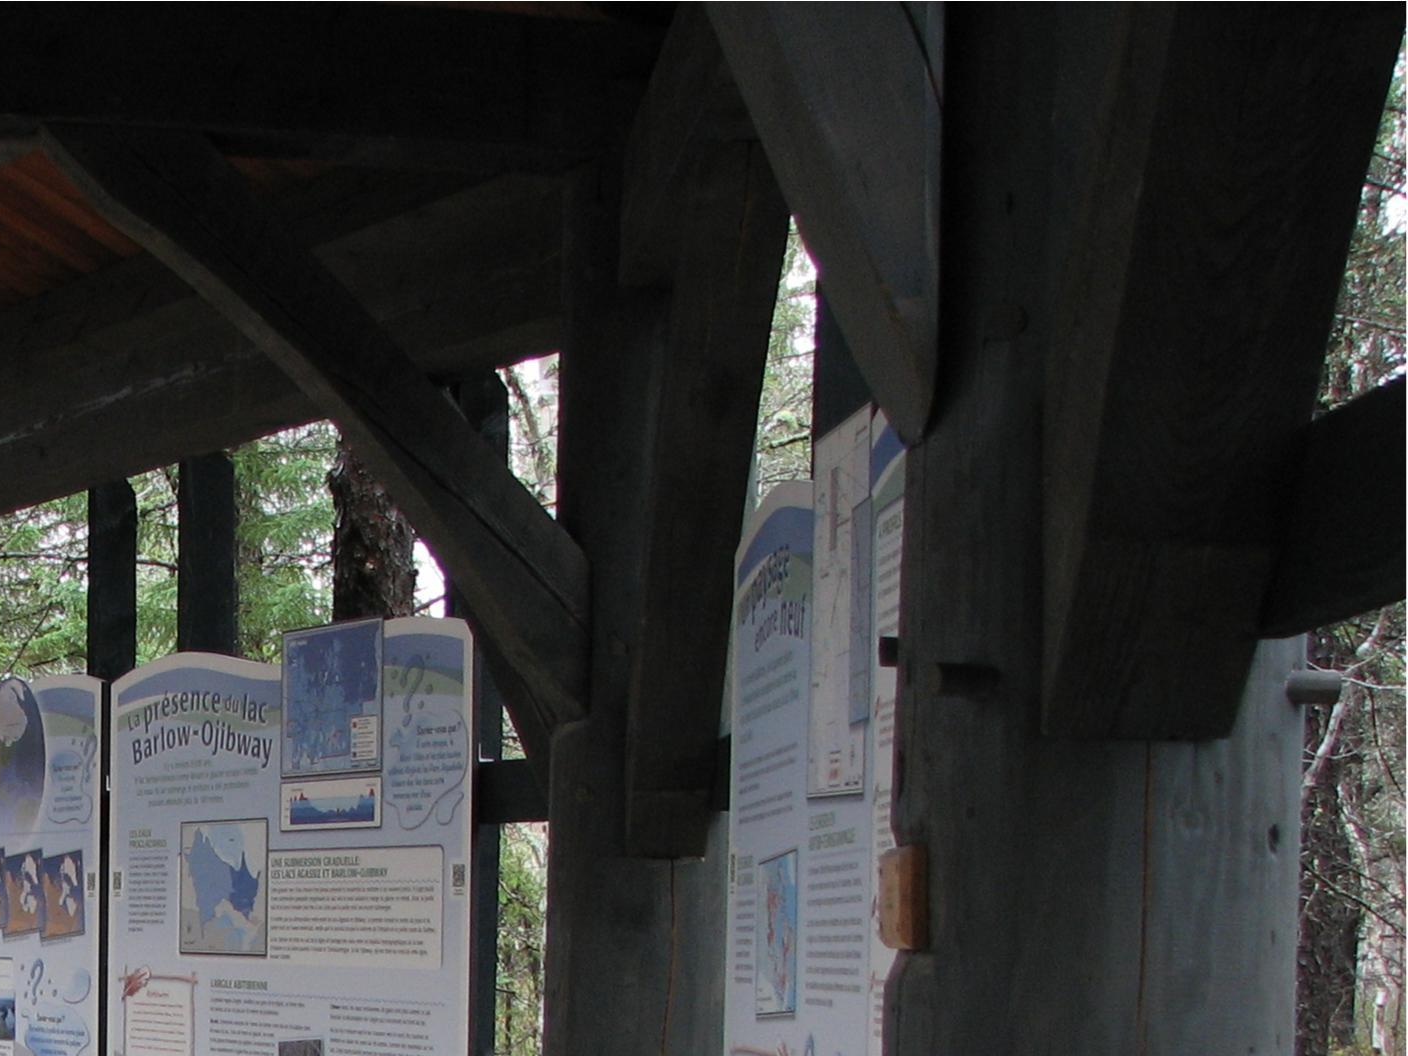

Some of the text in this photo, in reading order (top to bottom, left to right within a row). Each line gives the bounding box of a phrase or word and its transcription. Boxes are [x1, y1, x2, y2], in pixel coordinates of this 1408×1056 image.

[127, 690, 267, 733] La présence du lac
[132, 720, 273, 768] Barlow-Ojibway
